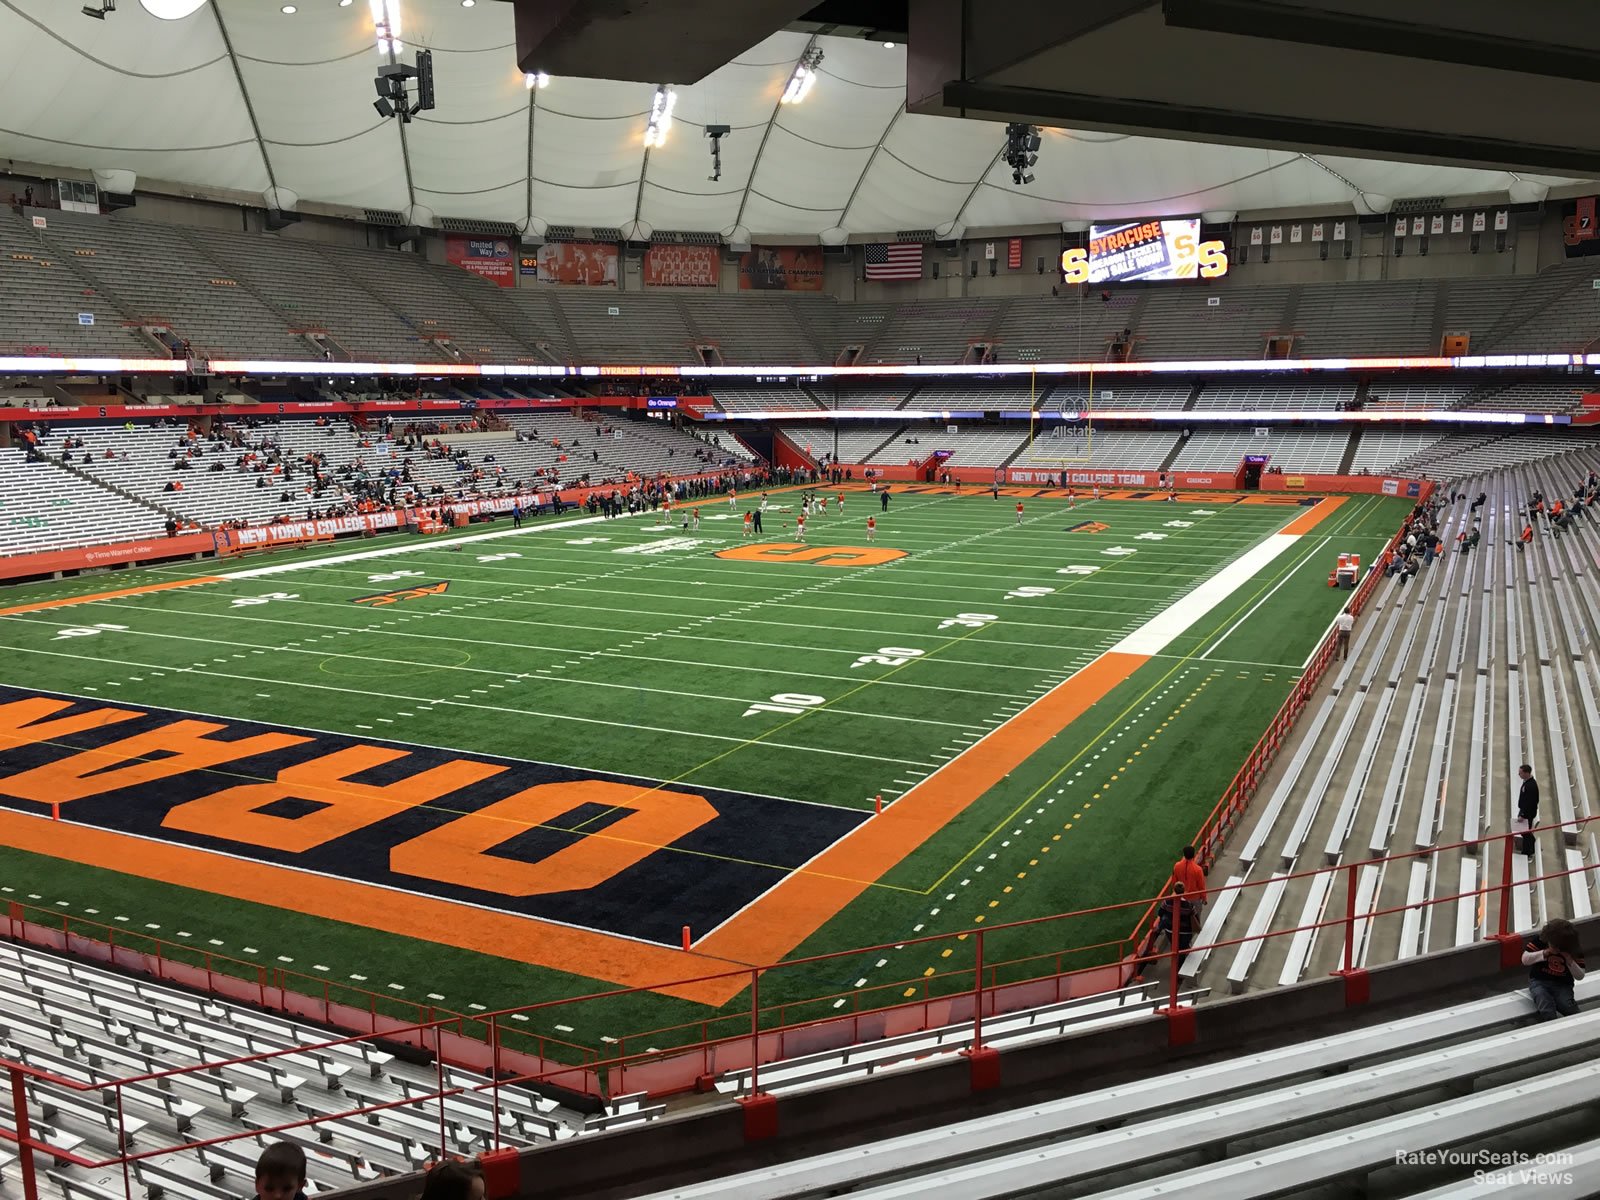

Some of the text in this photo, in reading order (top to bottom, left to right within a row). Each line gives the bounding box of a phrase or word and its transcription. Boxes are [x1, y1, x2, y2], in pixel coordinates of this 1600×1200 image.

[1581, 217, 1589, 229] 7
[1089, 221, 1163, 255] SYRACUSE
[470, 241, 493, 249] United
[479, 249, 493, 257] Way
[1198, 240, 1229, 278] S
[1062, 248, 1089, 283] S
[787, 269, 824, 277] CHAMPIONS
[601, 367, 641, 375] SYRACUSE
[648, 399, 678, 408] Go Orange
[1051, 425, 1098, 438] Allstate
[1012, 472, 1032, 482] NEW
[1072, 473, 1115, 484] COLLEGE
[1117, 474, 1146, 485] TEAM
[479, 498, 516, 513] COLLEGE
[517, 495, 540, 509] TEAM
[237, 512, 398, 545] NEW YORK'S COLLEGE TEAM
[94, 546, 151, 559] Time Warner Cable
[1056, 564, 1101, 575] 50
[941, 612, 999, 628] 30
[855, 646, 926, 667] 20
[748, 692, 827, 715] 10
